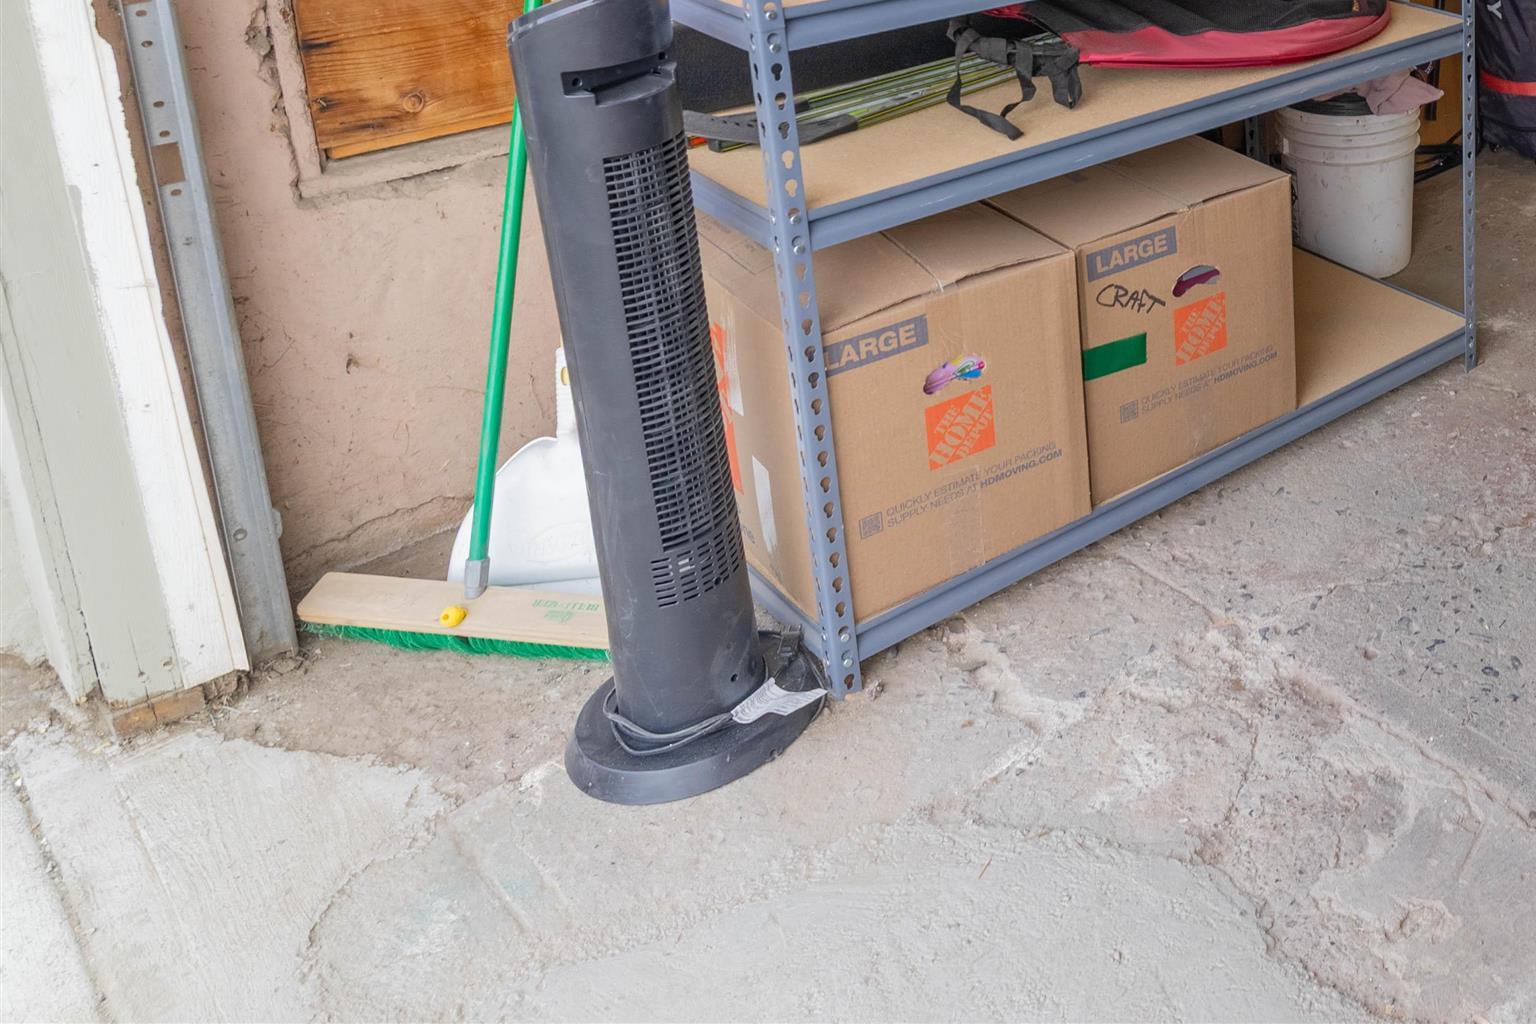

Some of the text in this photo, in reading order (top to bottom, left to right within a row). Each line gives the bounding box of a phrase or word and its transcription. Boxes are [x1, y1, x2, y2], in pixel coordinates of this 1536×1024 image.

[1095, 233, 1169, 272] LARGE
[825, 322, 918, 370] LARGE
[1176, 298, 1226, 362] HOME
[1213, 351, 1278, 385] HDMOVING.COM
[929, 392, 991, 464] HOME
[934, 406, 958, 434] THE
[958, 409, 994, 457] DEPOT
[886, 441, 1057, 517] QUICKLY ESTIMATE YOUR PACKING
[887, 448, 1063, 528] SUPPLY NEEDS AT HDMOVING.COM
